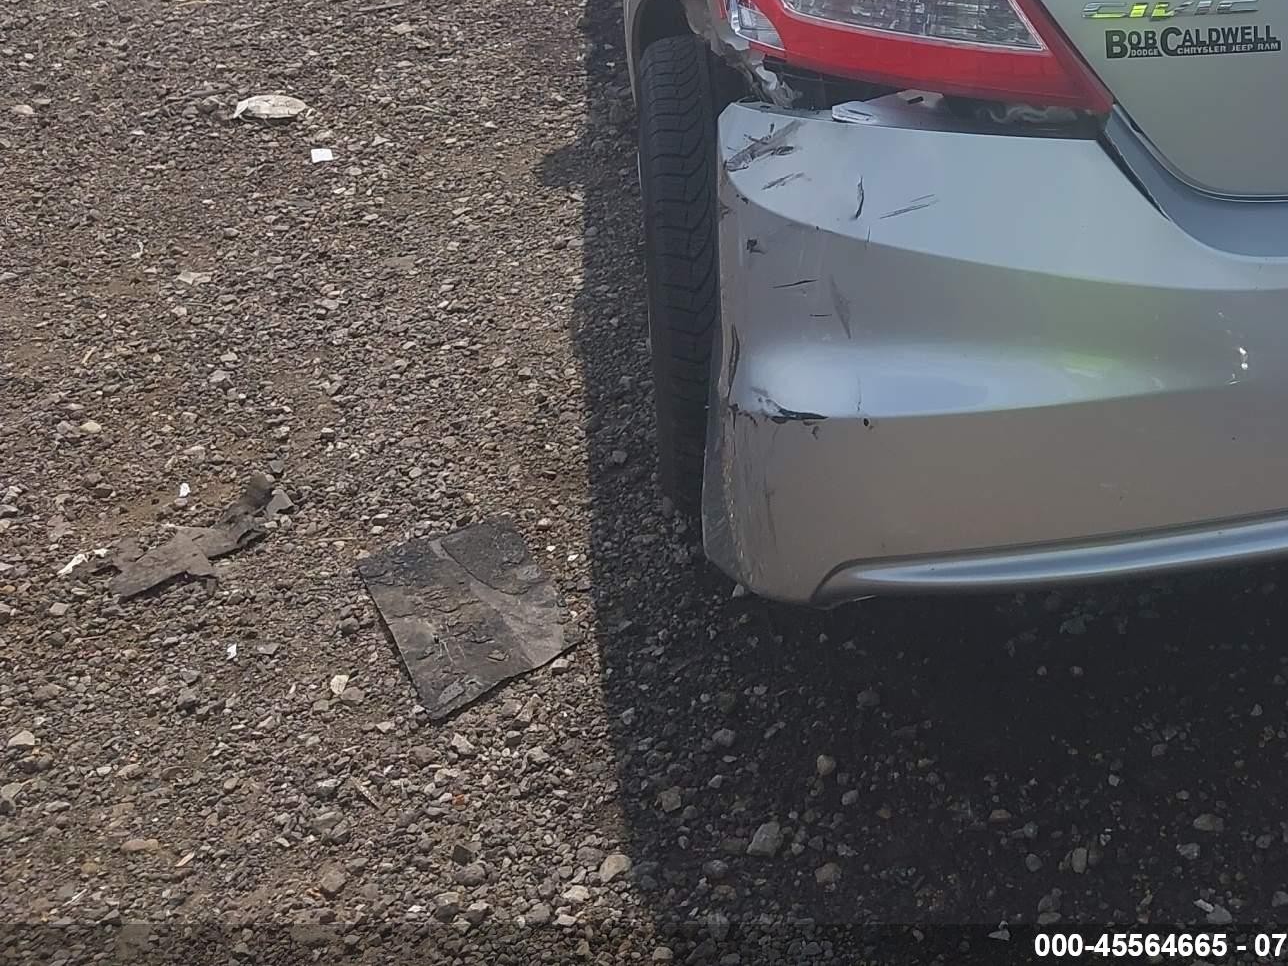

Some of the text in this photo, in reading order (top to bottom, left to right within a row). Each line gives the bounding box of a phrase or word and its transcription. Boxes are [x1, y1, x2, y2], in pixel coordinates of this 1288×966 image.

[1105, 25, 1277, 58] BOB CALDWELL
[1131, 42, 1279, 57] DODGE CHRYSLER JEEP RAM
